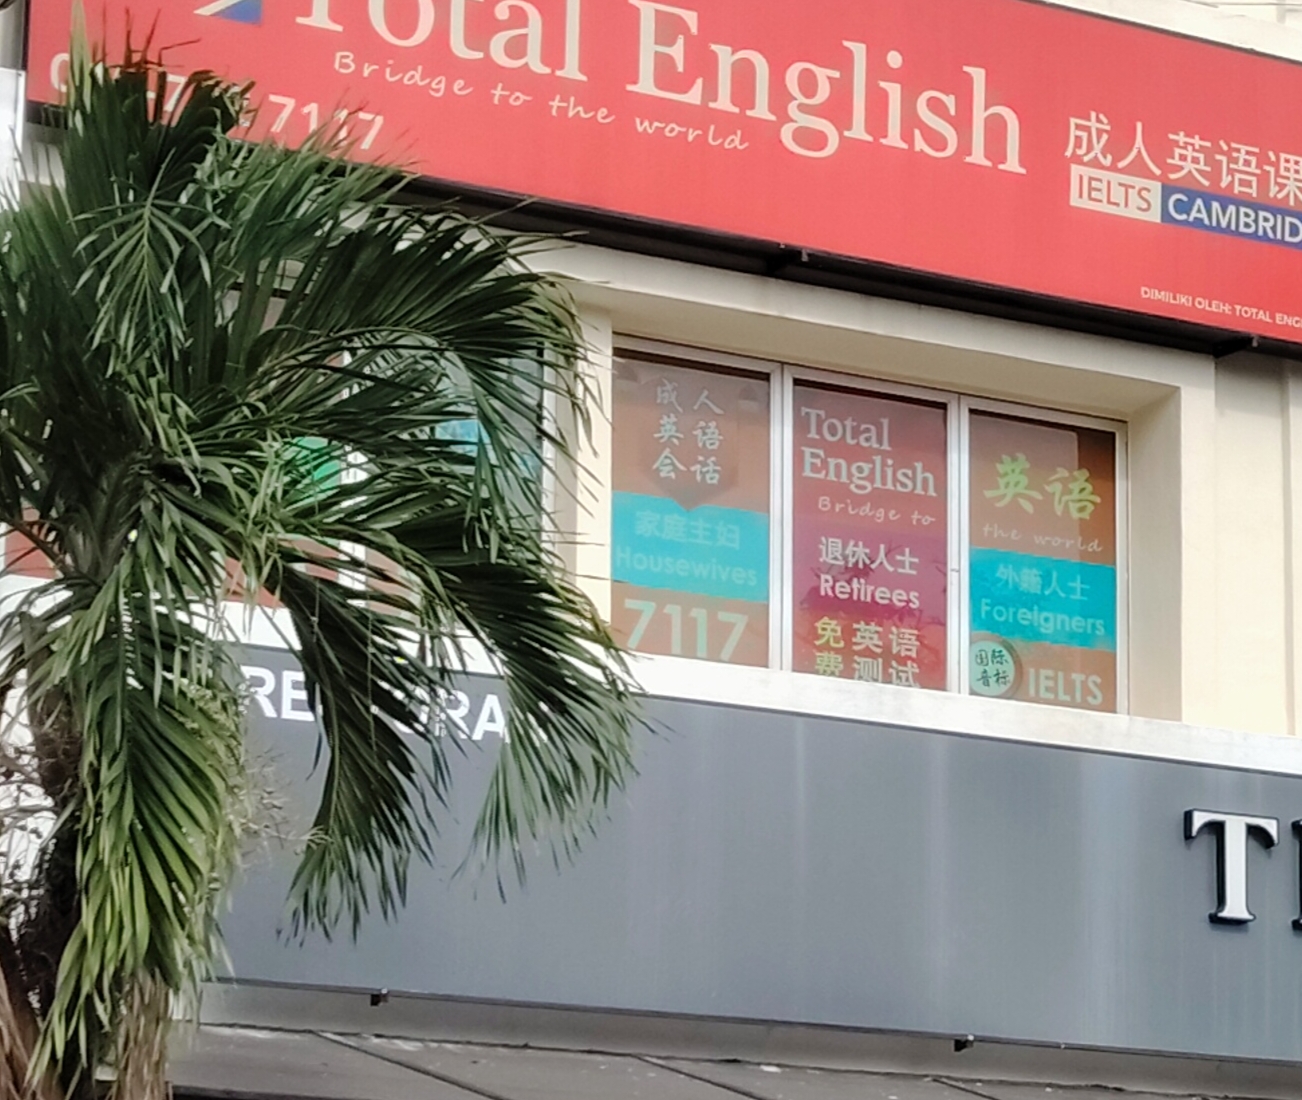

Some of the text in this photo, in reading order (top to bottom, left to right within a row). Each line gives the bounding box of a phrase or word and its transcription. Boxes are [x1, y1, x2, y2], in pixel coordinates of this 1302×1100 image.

[295, 0, 1027, 174] otal English
[334, 51, 750, 151] Bridge to the world
[1077, 173, 1153, 213] IELTS
[1140, 286, 1193, 308] DIMILIKI
[1194, 297, 1233, 315] OLEH:
[1234, 304, 1274, 323] TOTAL
[801, 406, 892, 451] Total
[801, 446, 938, 497] English
[983, 453, 1101, 521] 英语
[818, 496, 936, 526] Bridge to
[819, 536, 920, 576] 退休人士
[982, 522, 1103, 553] the world
[615, 545, 758, 587] Housewives
[820, 573, 921, 610] Retirees
[624, 598, 749, 662] 7117
[980, 598, 1106, 636] Foreigners
[1028, 668, 1103, 705] IELTS
